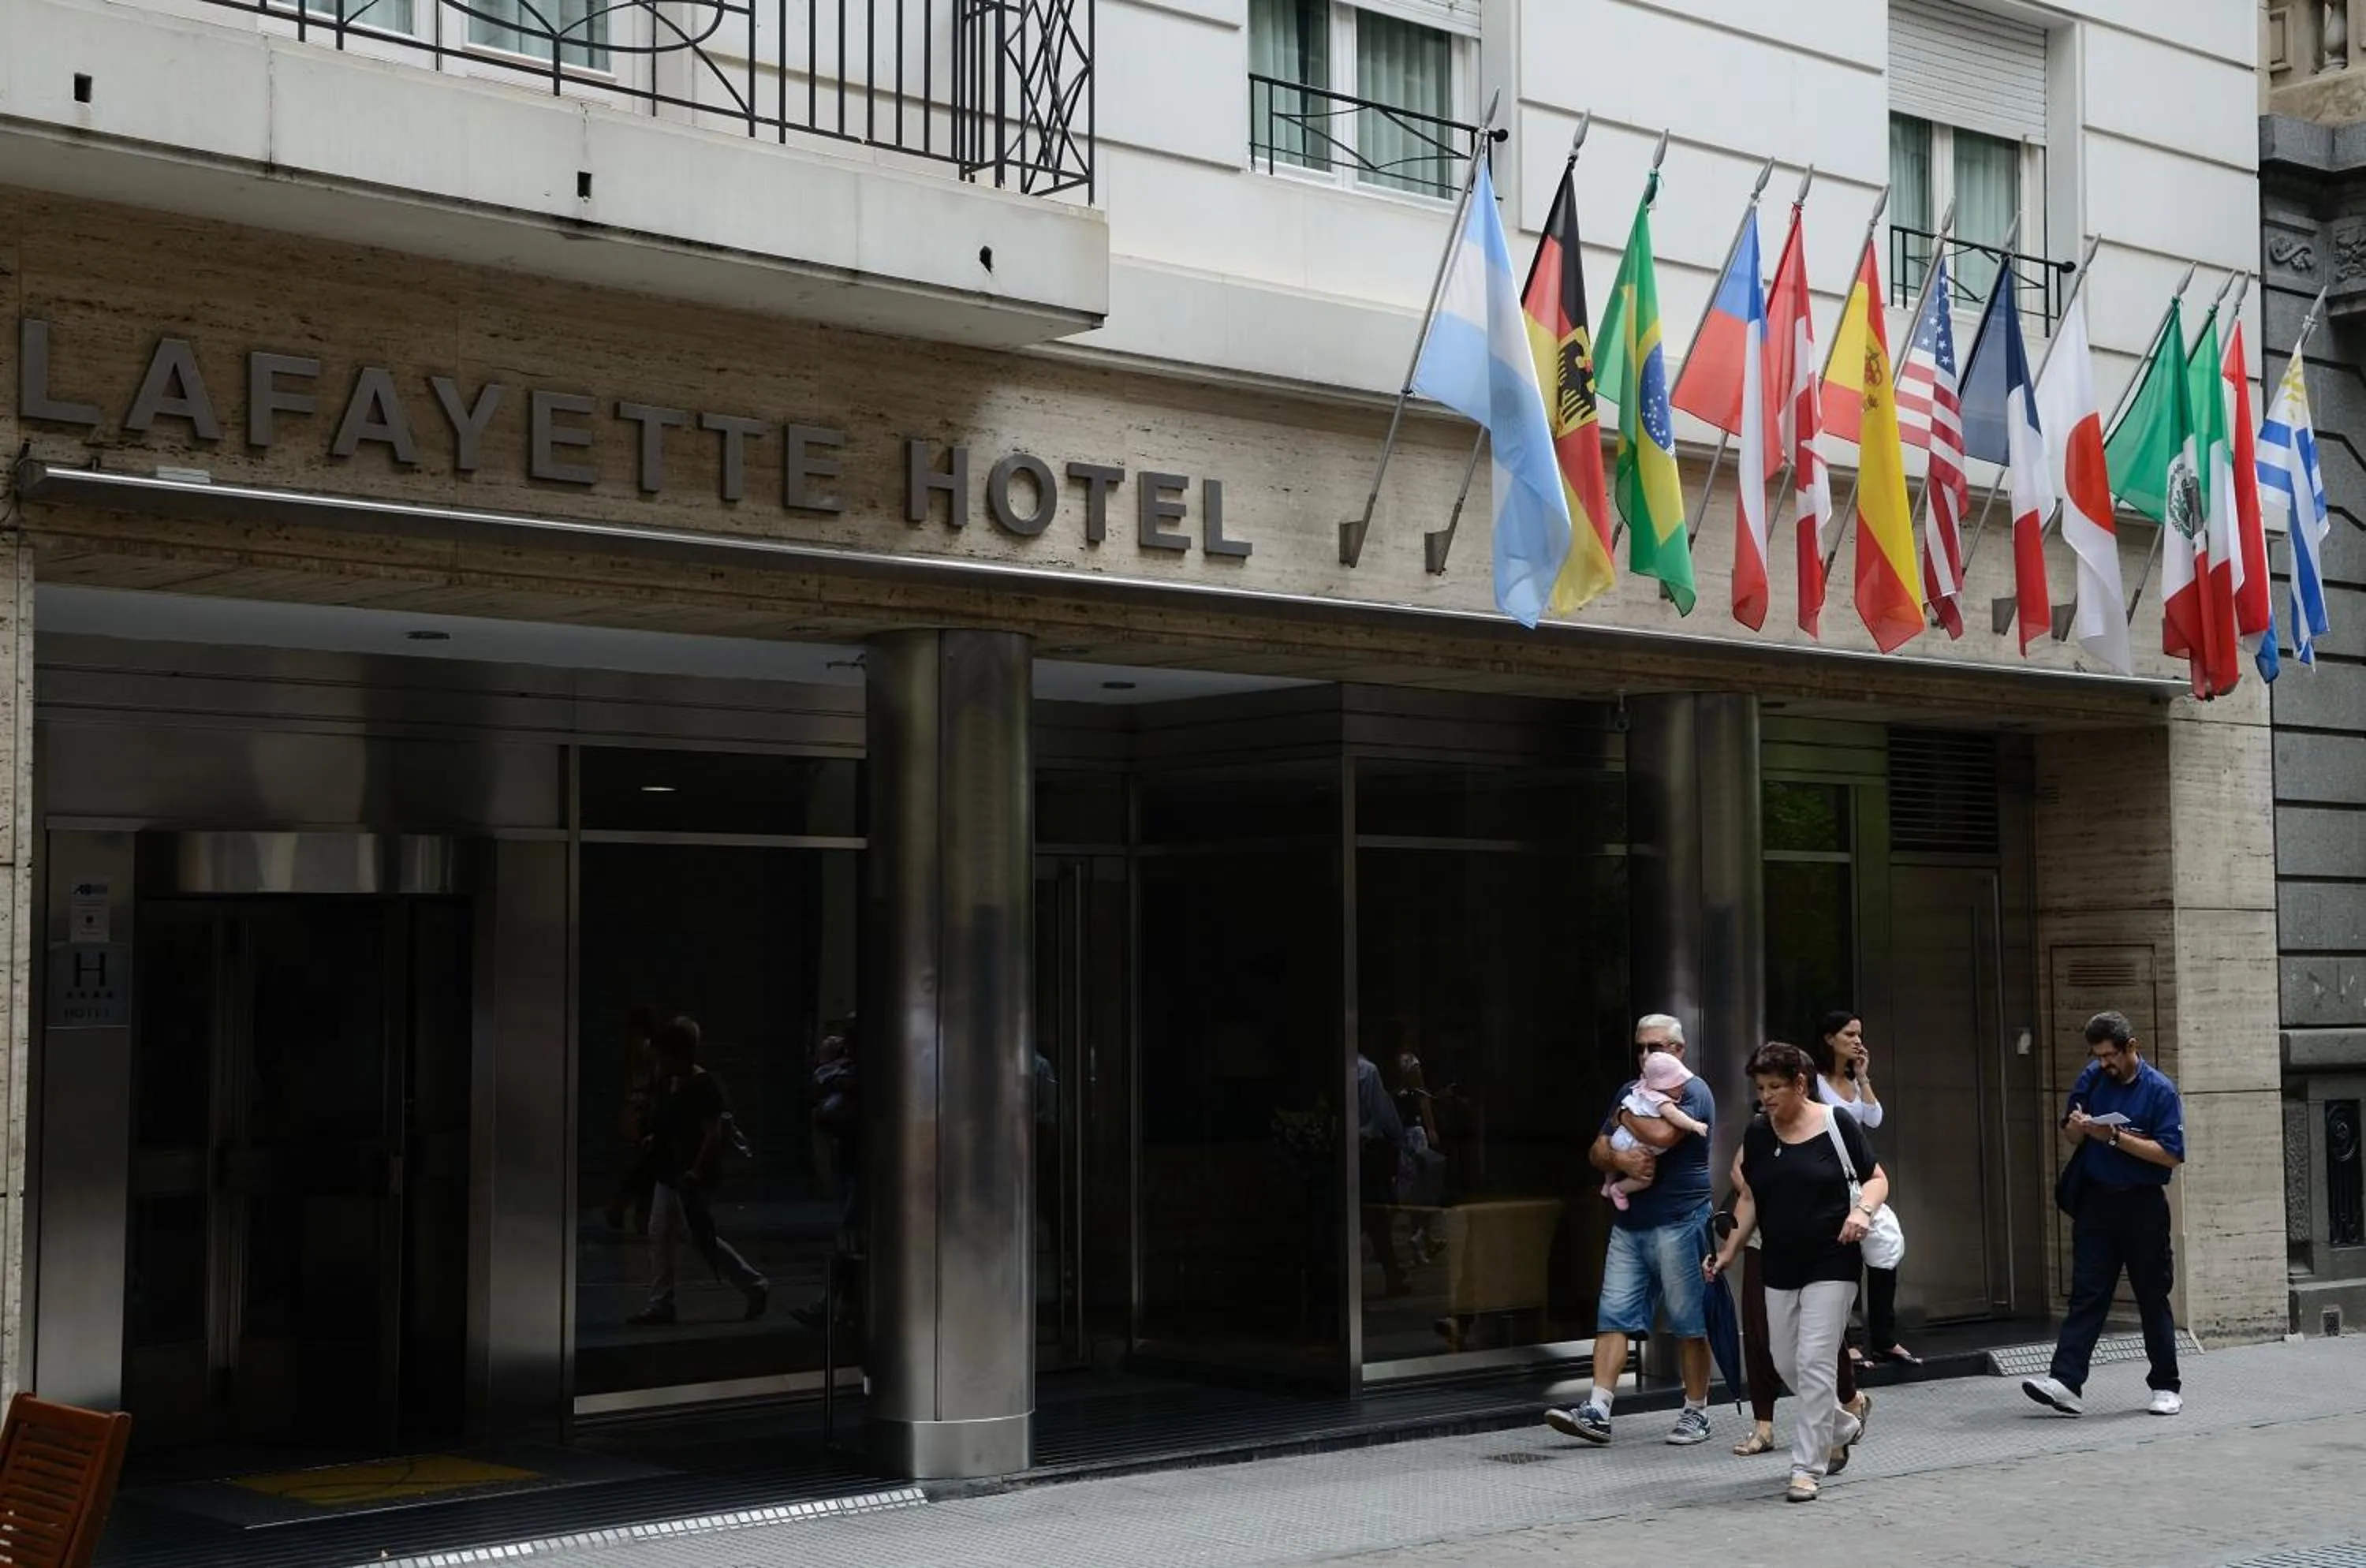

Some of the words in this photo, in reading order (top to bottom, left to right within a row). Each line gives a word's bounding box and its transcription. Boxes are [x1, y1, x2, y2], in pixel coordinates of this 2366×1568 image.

[19, 318, 845, 513] LAFAYETTE
[904, 436, 1252, 558] HOTEL
[74, 952, 106, 988] H
[64, 1007, 114, 1019] HOTEL
